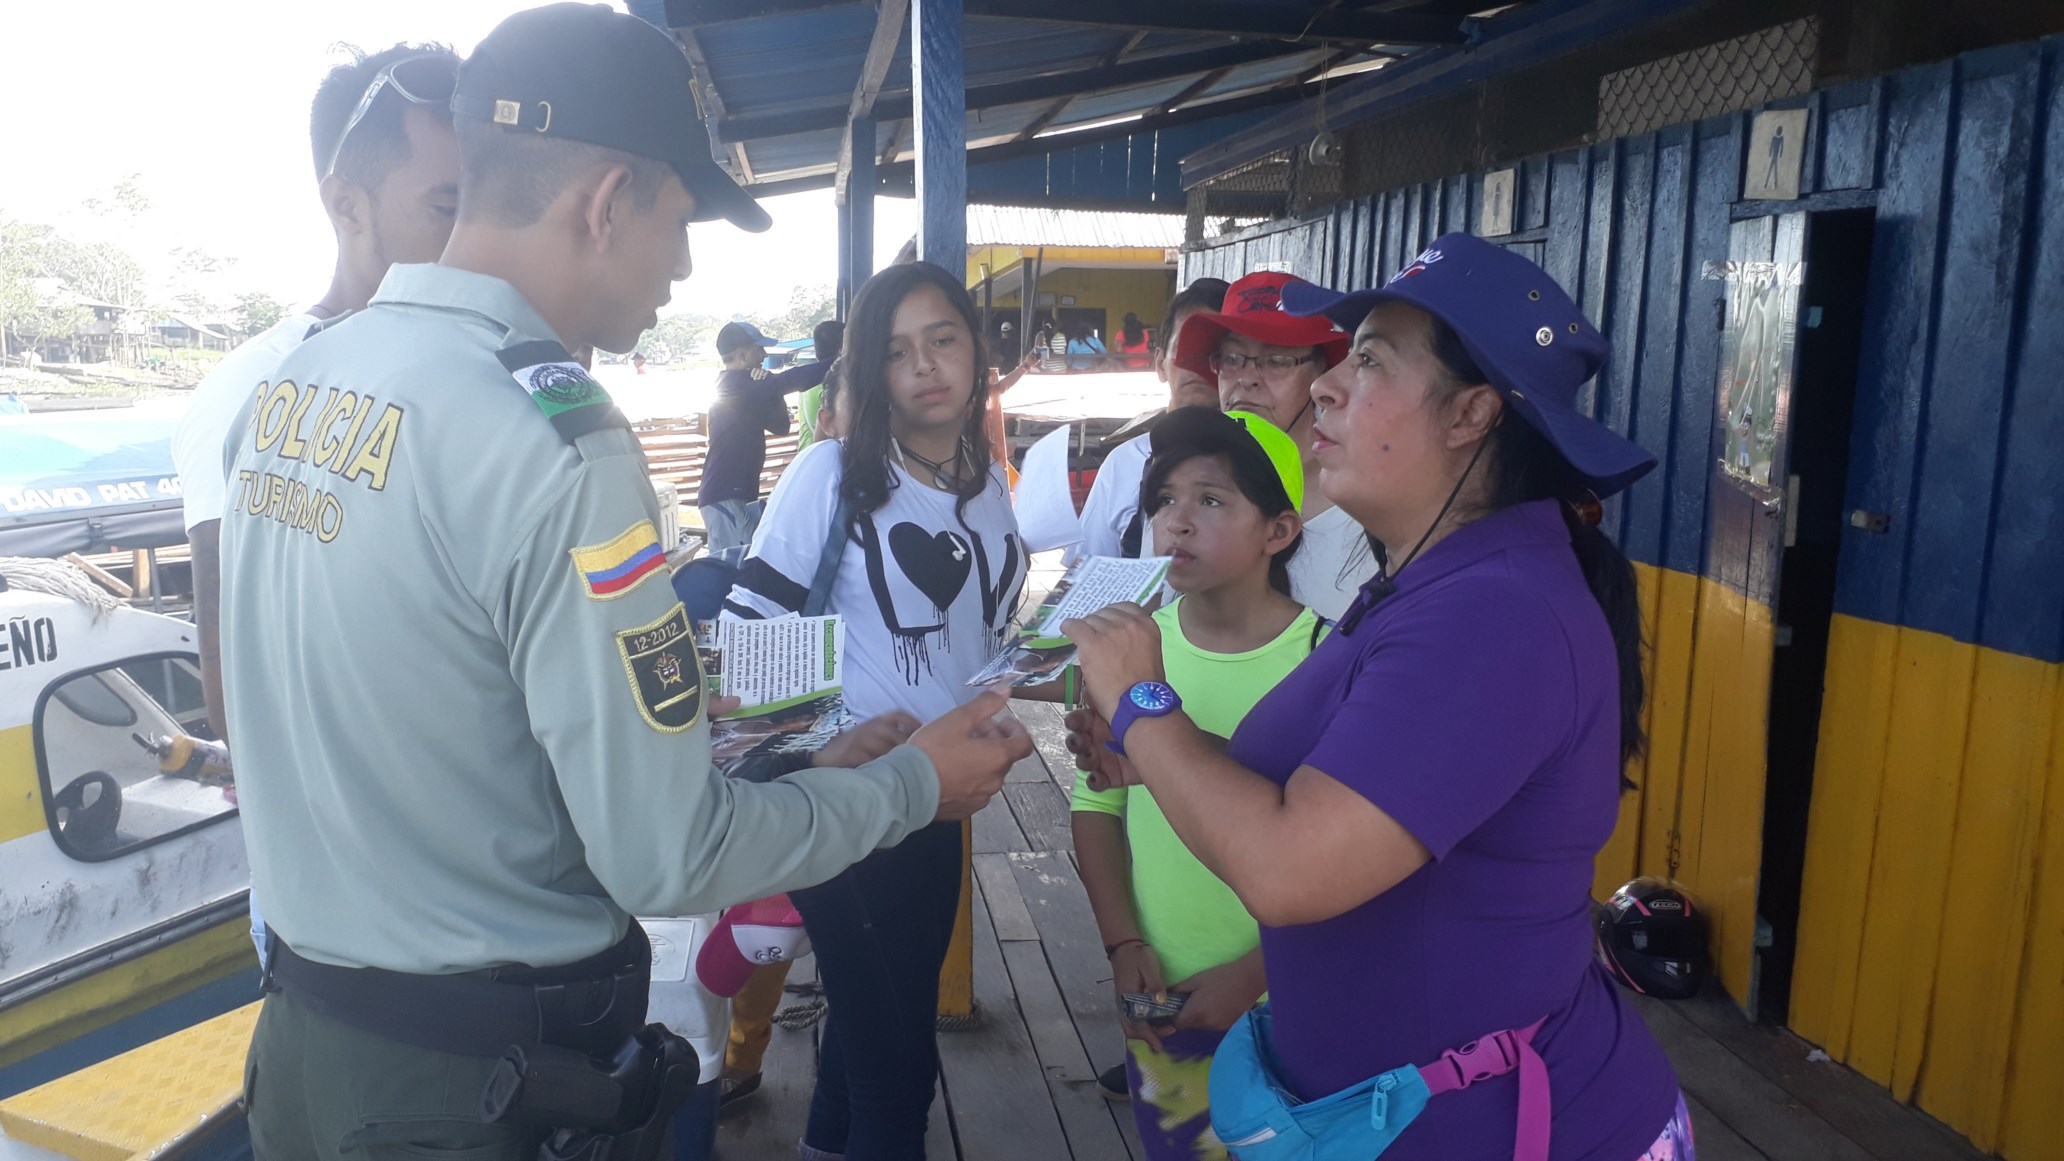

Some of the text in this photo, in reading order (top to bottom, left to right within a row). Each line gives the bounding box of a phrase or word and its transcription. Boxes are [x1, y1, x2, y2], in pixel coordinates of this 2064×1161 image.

[97, 480, 151, 503] PAT
[235, 469, 343, 543] TURISMO
[633, 622, 679, 652] 12-2012
